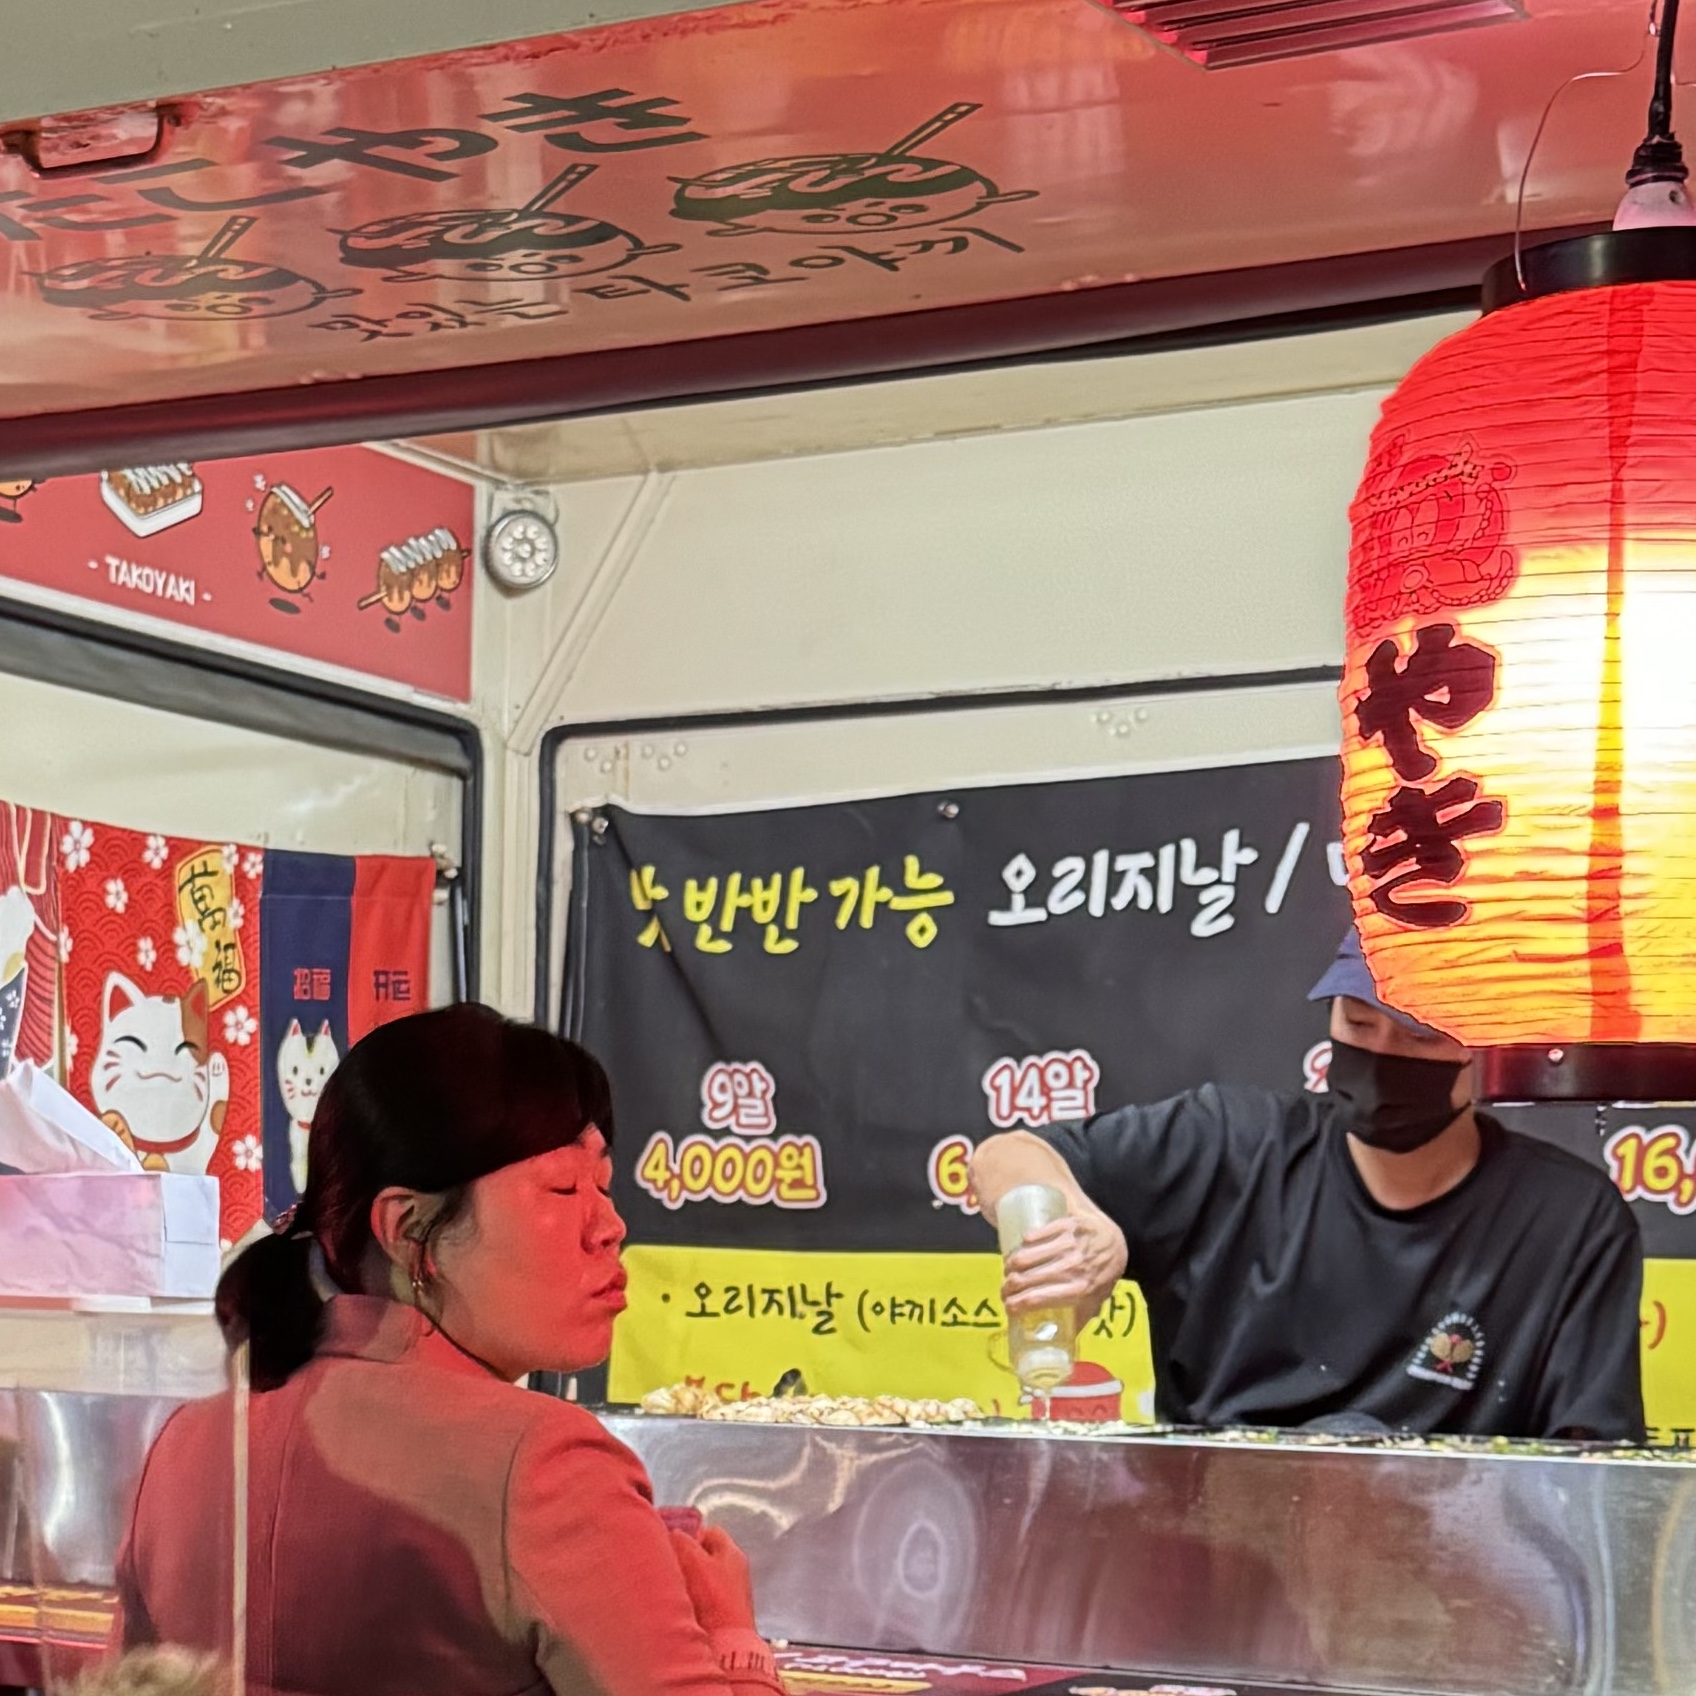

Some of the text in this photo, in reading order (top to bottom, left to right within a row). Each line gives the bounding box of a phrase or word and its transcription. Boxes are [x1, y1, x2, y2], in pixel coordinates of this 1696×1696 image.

[307, 226, 1026, 343] 맛있는 타코야끼
[105, 555, 196, 606] TAKOYAKI
[682, 865, 817, 954] 반반
[829, 853, 955, 949] 가능
[988, 828, 1260, 938] 오리지날
[705, 1063, 776, 1133] 9알
[986, 1052, 1098, 1123] 14알
[637, 1135, 823, 1207] 4,000원
[1609, 1129, 1696, 1209] 16,
[684, 1280, 844, 1336] 오리지날
